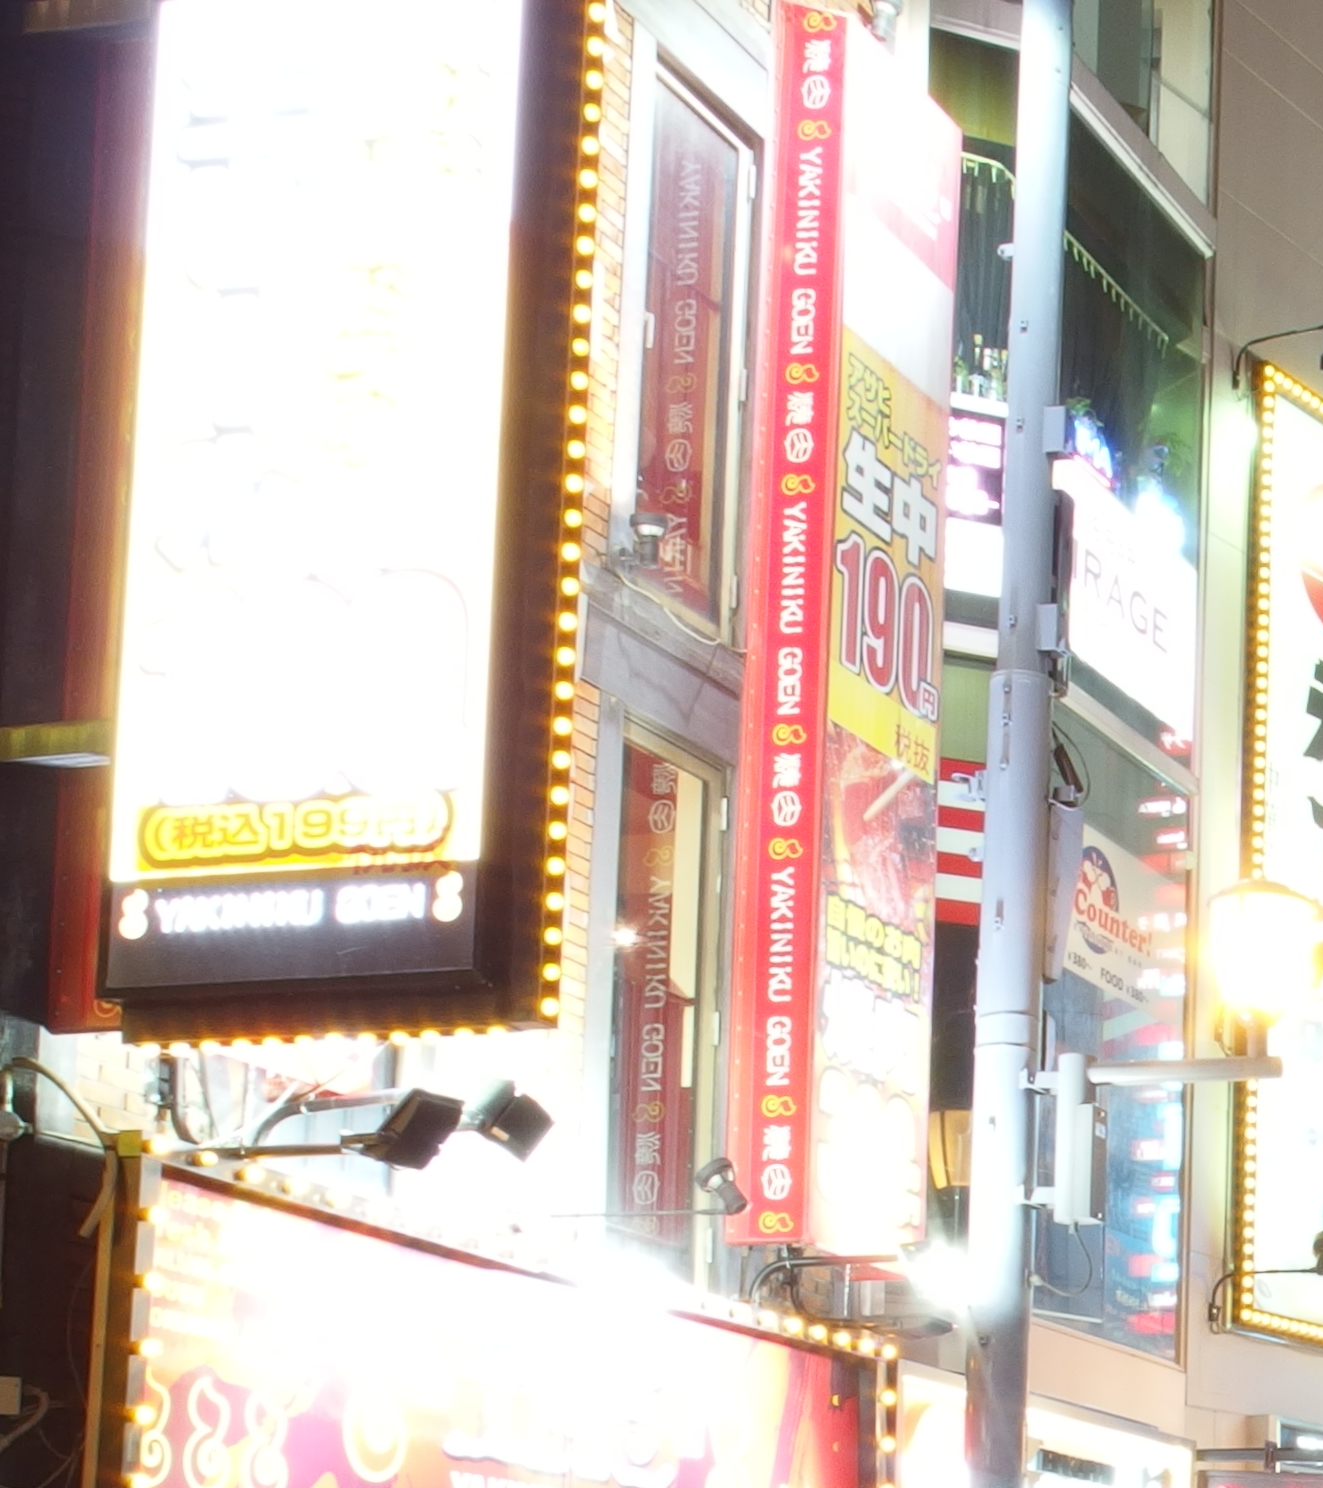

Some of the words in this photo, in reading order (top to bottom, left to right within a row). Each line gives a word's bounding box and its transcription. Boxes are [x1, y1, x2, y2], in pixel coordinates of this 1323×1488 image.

[795, 146, 824, 276] YAKINIKU
[790, 288, 816, 355] GOEN
[847, 388, 942, 491] スーパードライ
[842, 427, 939, 566] 生中
[779, 500, 809, 635] YAKINIKU
[776, 646, 803, 716] GOEN
[894, 723, 931, 776] 税抜
[767, 866, 796, 1004] YAKINIKU
[1073, 887, 1153, 958] Counter!
[765, 1014, 792, 1086] GOEN
